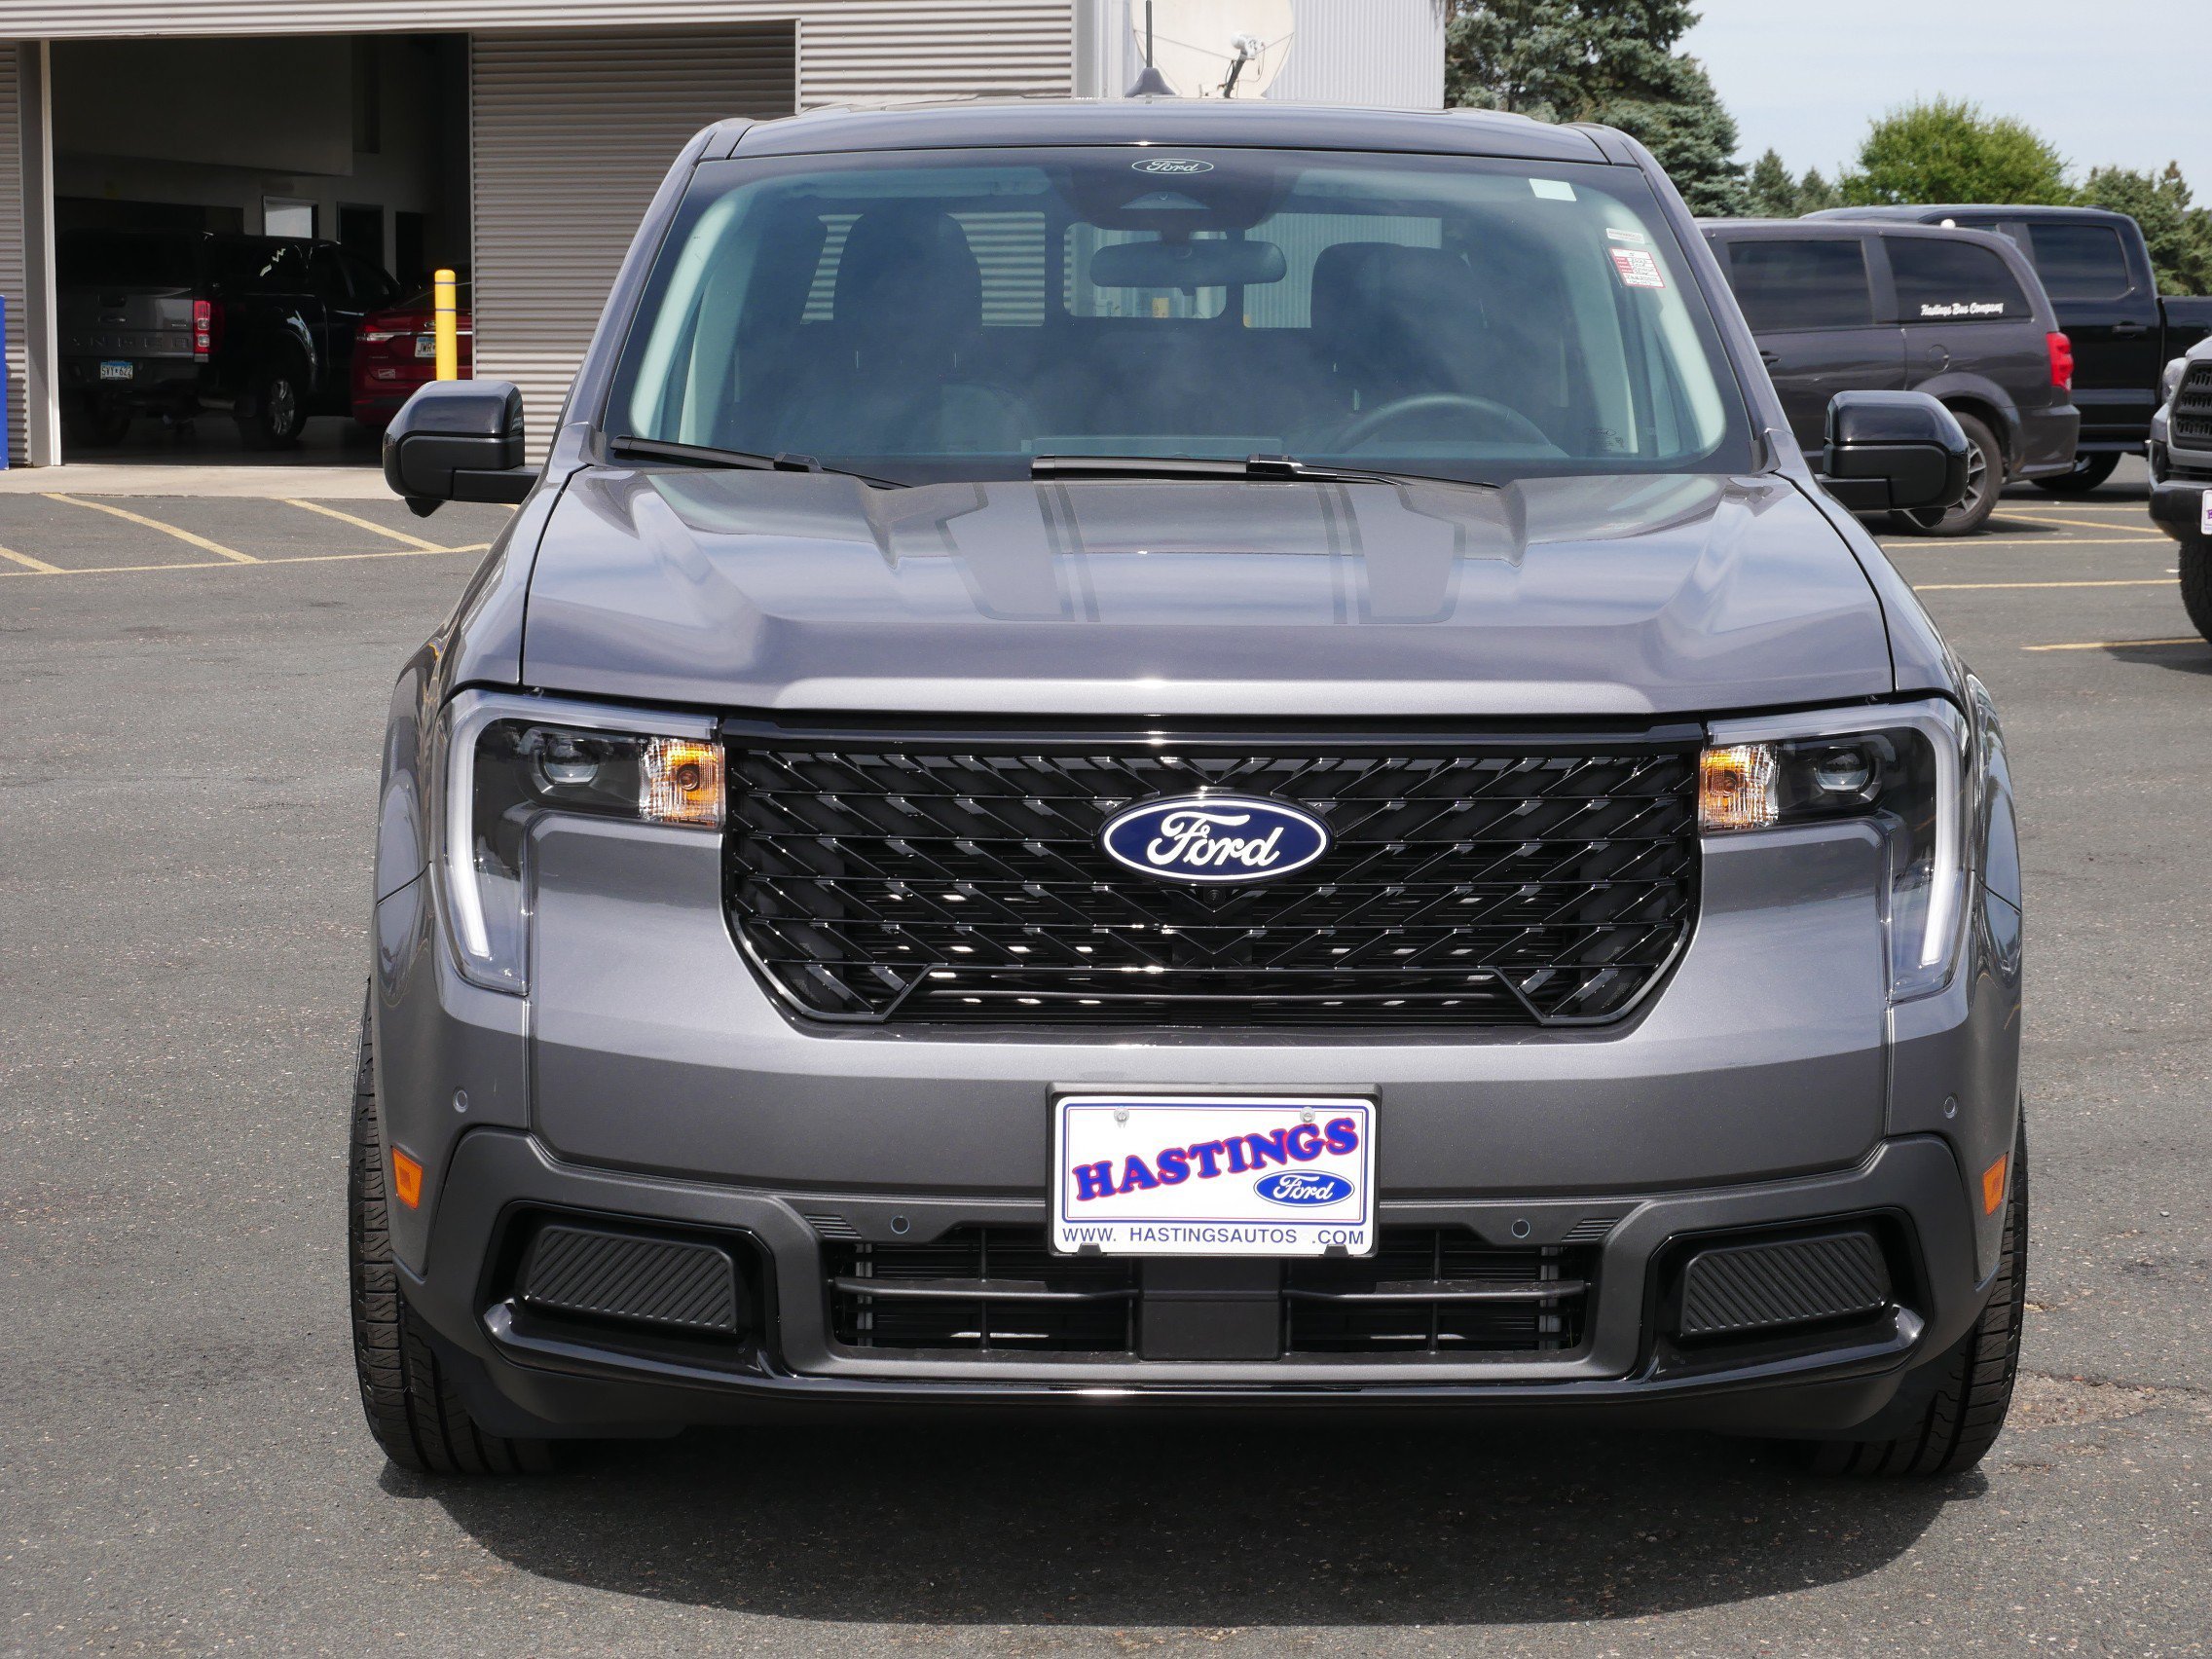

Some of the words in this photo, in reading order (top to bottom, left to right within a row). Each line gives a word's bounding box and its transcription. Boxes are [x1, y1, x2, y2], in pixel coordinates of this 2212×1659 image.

[1146, 160, 1199, 172] Ford
[1146, 810, 1284, 866] Ford
[1072, 1117, 1359, 1201] HASTINGS
[1272, 1171, 1334, 1200] Ford
[1129, 1227, 1298, 1244] HASTINGSAUTOS
